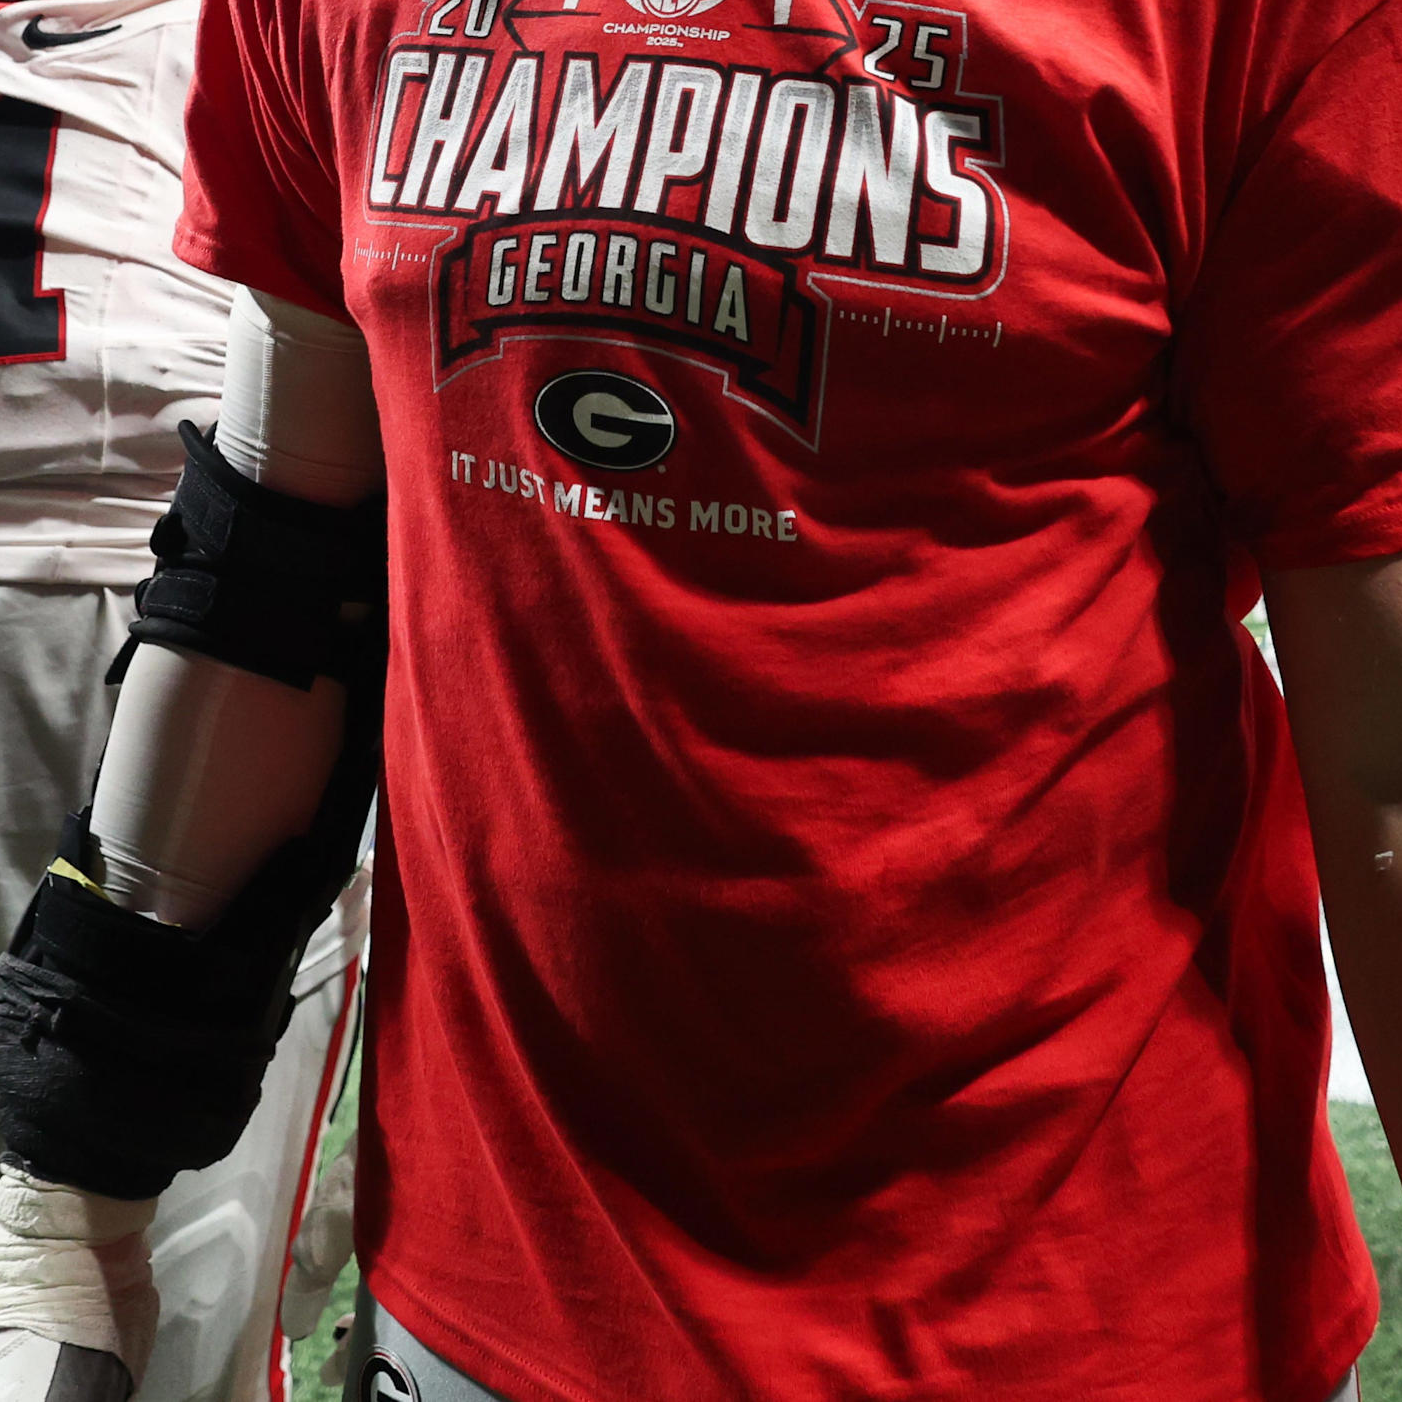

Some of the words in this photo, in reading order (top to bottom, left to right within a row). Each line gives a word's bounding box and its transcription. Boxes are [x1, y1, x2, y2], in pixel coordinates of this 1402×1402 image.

[602, 22, 731, 41] CHAMPIONSHIP
[863, 16, 950, 89] 25
[371, 51, 991, 276] CHAMPIONS
[487, 229, 749, 343] GEORGIA
[451, 450, 476, 484] IT
[483, 459, 545, 505] JUST
[554, 481, 676, 530] MEANS
[690, 501, 797, 541] MORE
